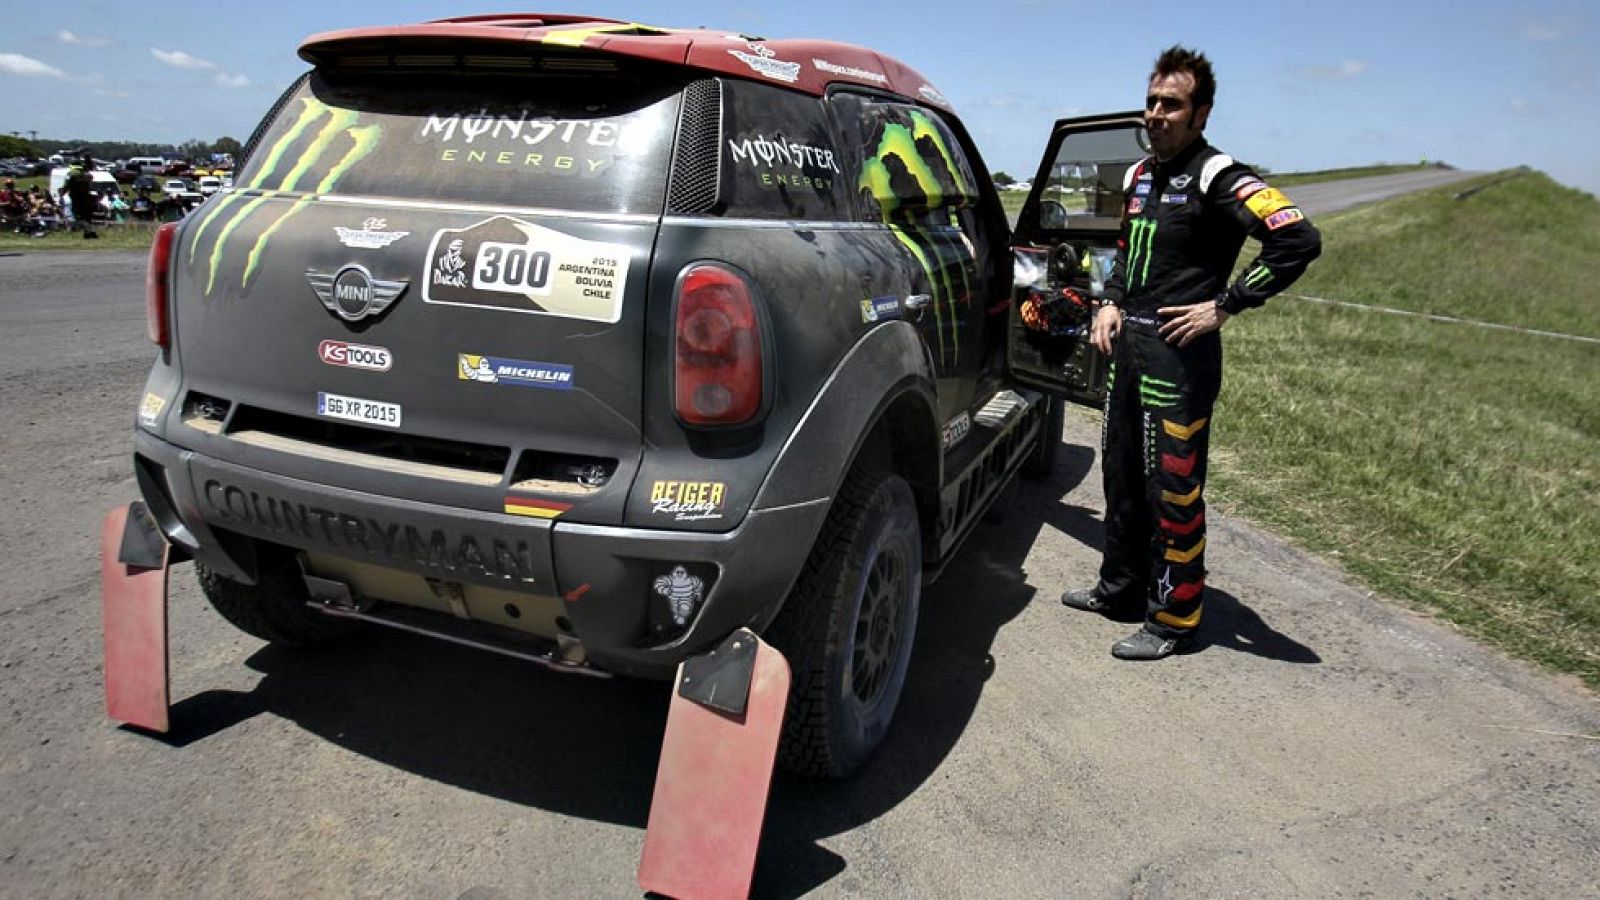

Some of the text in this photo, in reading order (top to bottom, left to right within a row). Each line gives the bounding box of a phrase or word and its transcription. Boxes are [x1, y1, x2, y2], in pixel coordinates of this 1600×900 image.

[421, 108, 640, 146] MONSTE
[441, 149, 605, 172] ENERGY
[728, 135, 840, 174] MONSTER
[761, 172, 833, 189] ENERGY
[478, 245, 551, 289] 300
[558, 263, 615, 278] ARGENTINA
[592, 257, 618, 267] 2015
[575, 276, 613, 289] BOLIVIA
[338, 283, 368, 301] MINI
[582, 287, 612, 300] CHILE
[497, 365, 572, 382] MICHELIN
[327, 398, 397, 422] GG XR 2015
[652, 497, 716, 516] Racing
[203, 479, 535, 583] COUNTRYMAN
